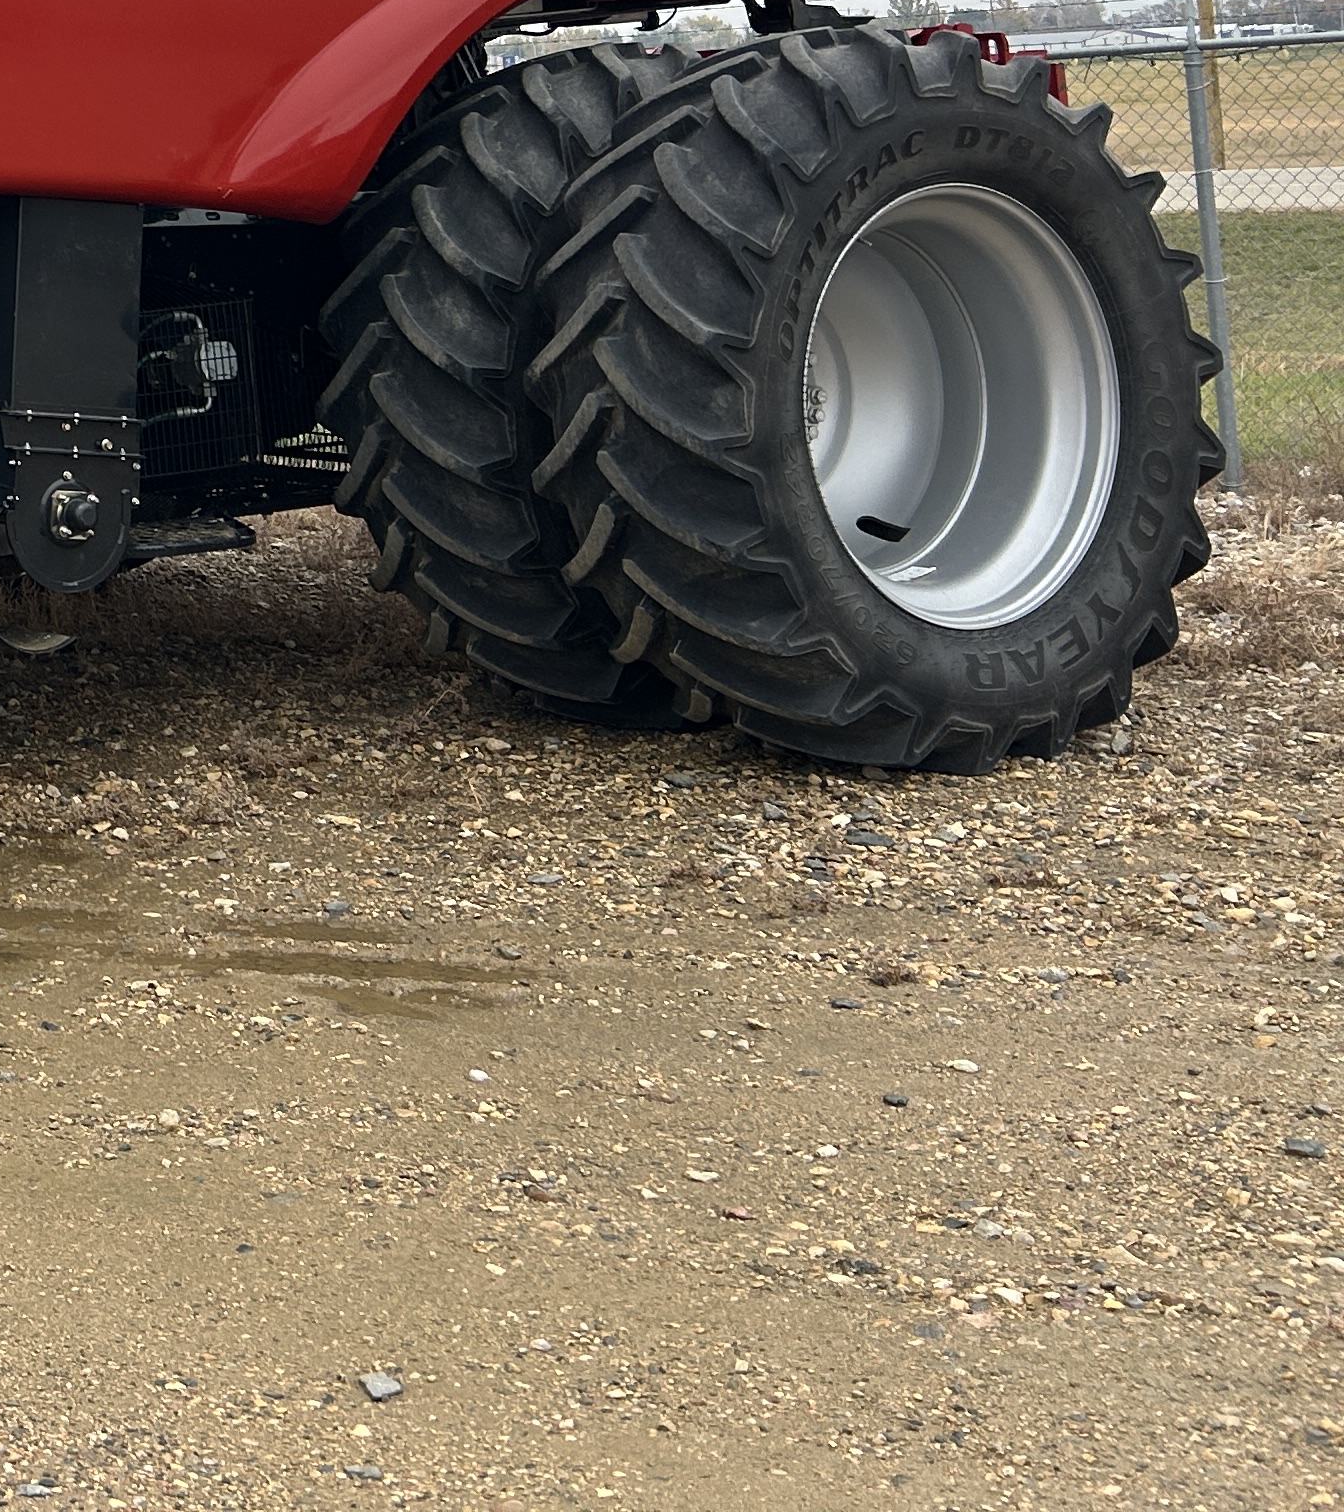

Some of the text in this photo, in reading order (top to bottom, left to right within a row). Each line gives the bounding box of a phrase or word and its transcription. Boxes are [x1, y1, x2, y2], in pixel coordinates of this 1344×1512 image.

[776, 124, 1077, 362] OPTITRAC DT812
[966, 342, 1178, 692] GOODYEAR
